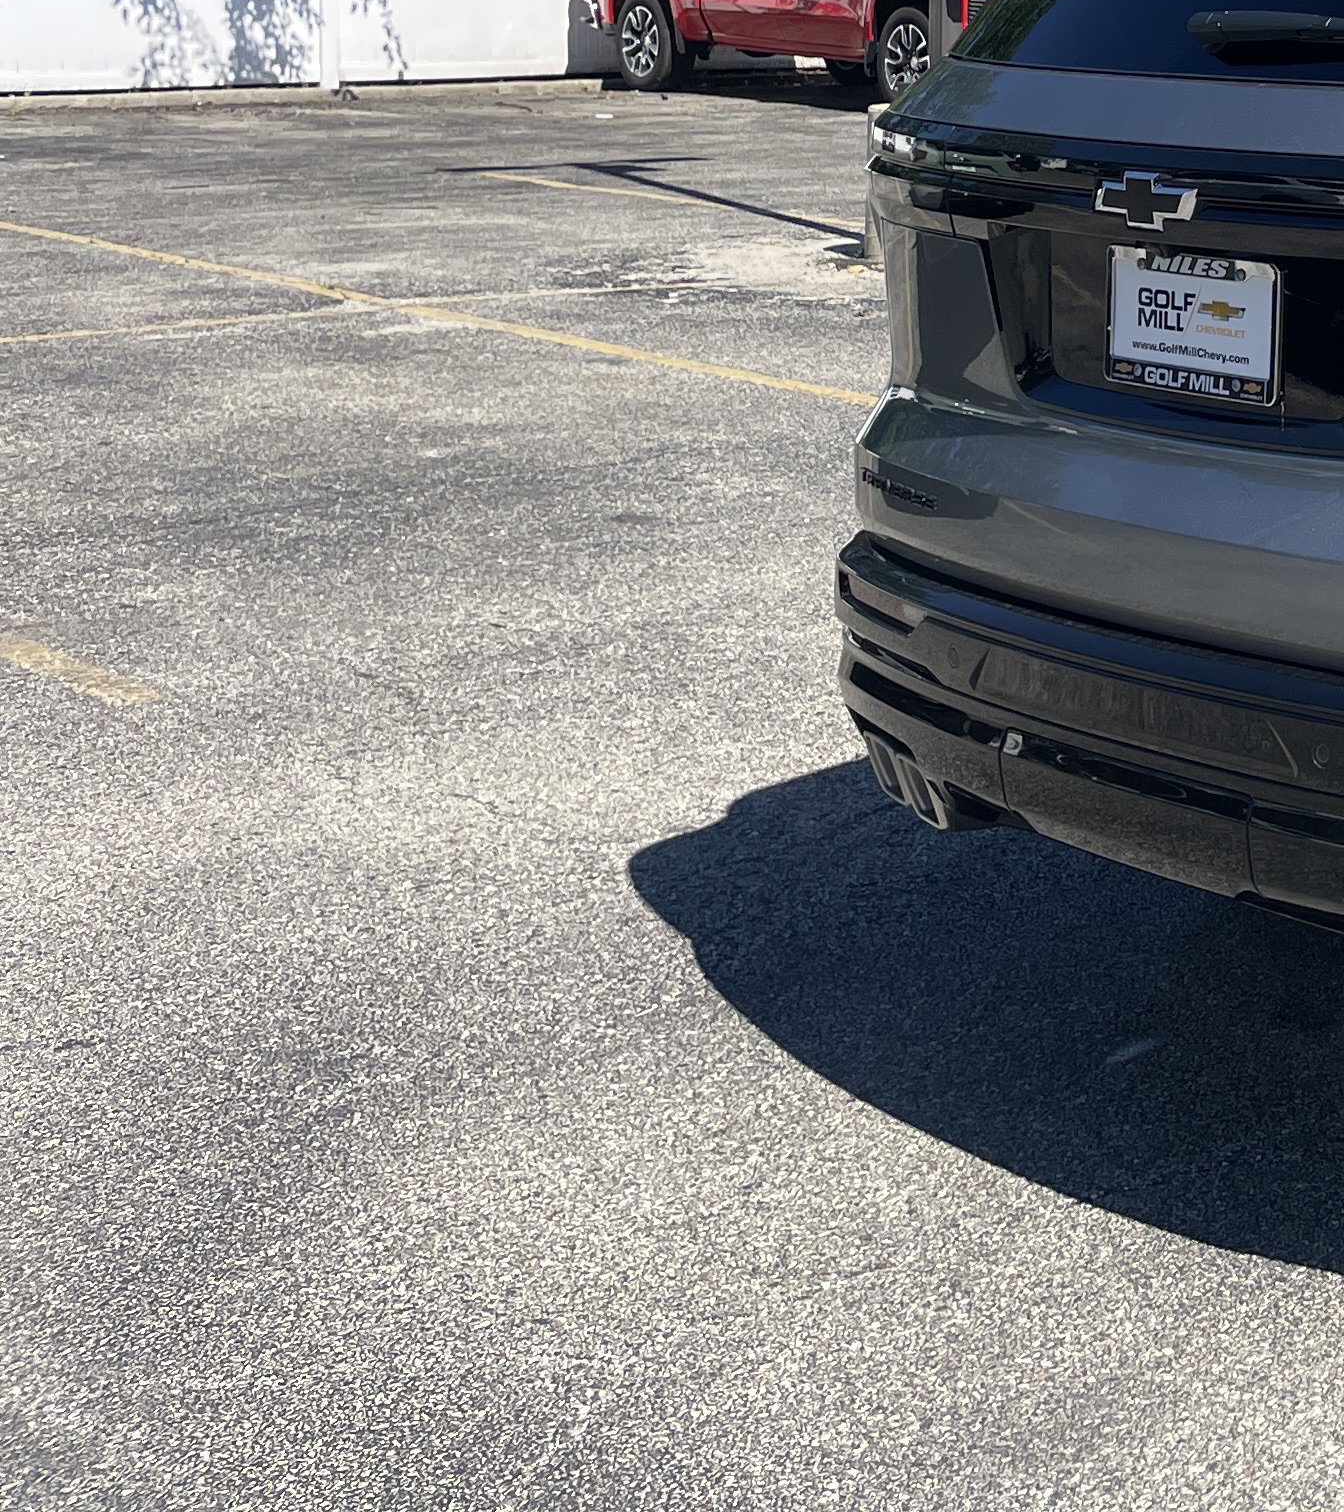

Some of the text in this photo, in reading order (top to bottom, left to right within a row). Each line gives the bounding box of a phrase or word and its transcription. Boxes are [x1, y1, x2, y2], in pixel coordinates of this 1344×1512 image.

[1151, 255, 1229, 278] NILES
[1138, 287, 1196, 312] GOLF
[1138, 308, 1185, 332] MILL
[1132, 340, 1249, 365] www.GolfMillChevy.com
[1144, 366, 1230, 396] GOLF MILL
